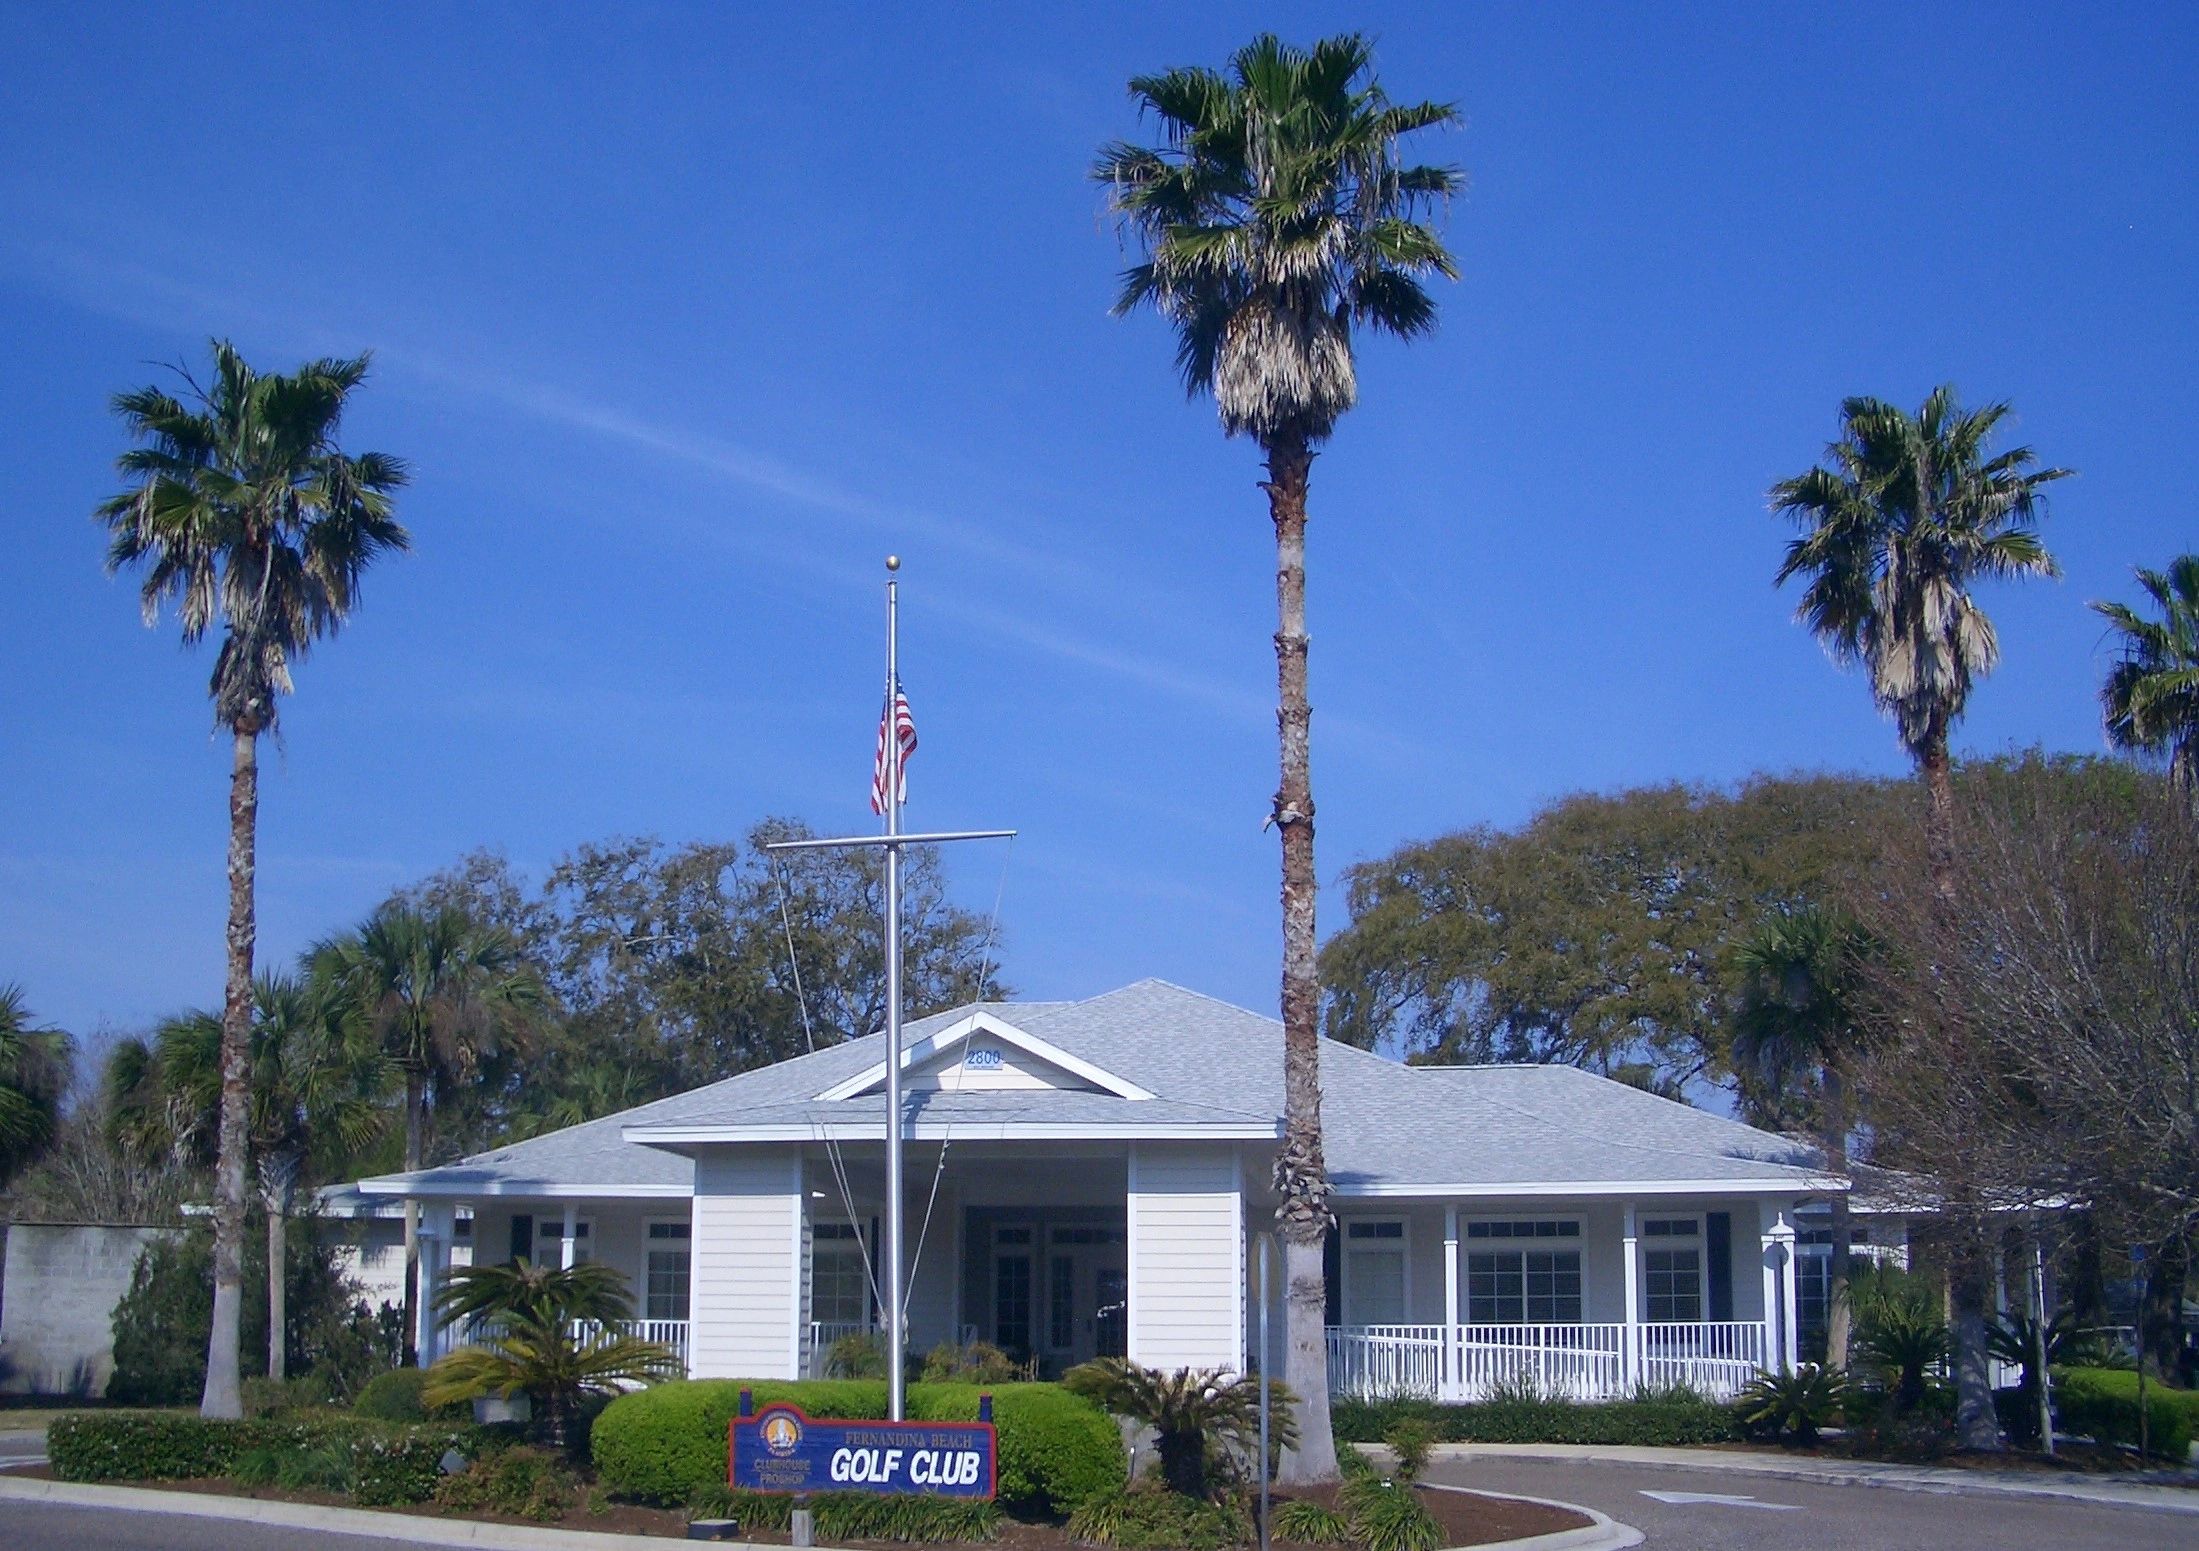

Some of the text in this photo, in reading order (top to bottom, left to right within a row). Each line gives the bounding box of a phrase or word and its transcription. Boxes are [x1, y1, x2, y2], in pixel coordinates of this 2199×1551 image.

[968, 1050, 1000, 1064] 2800
[845, 1431, 972, 1449] FERNANDINA BEACH
[830, 1448, 980, 1485] GOLF CLUB
